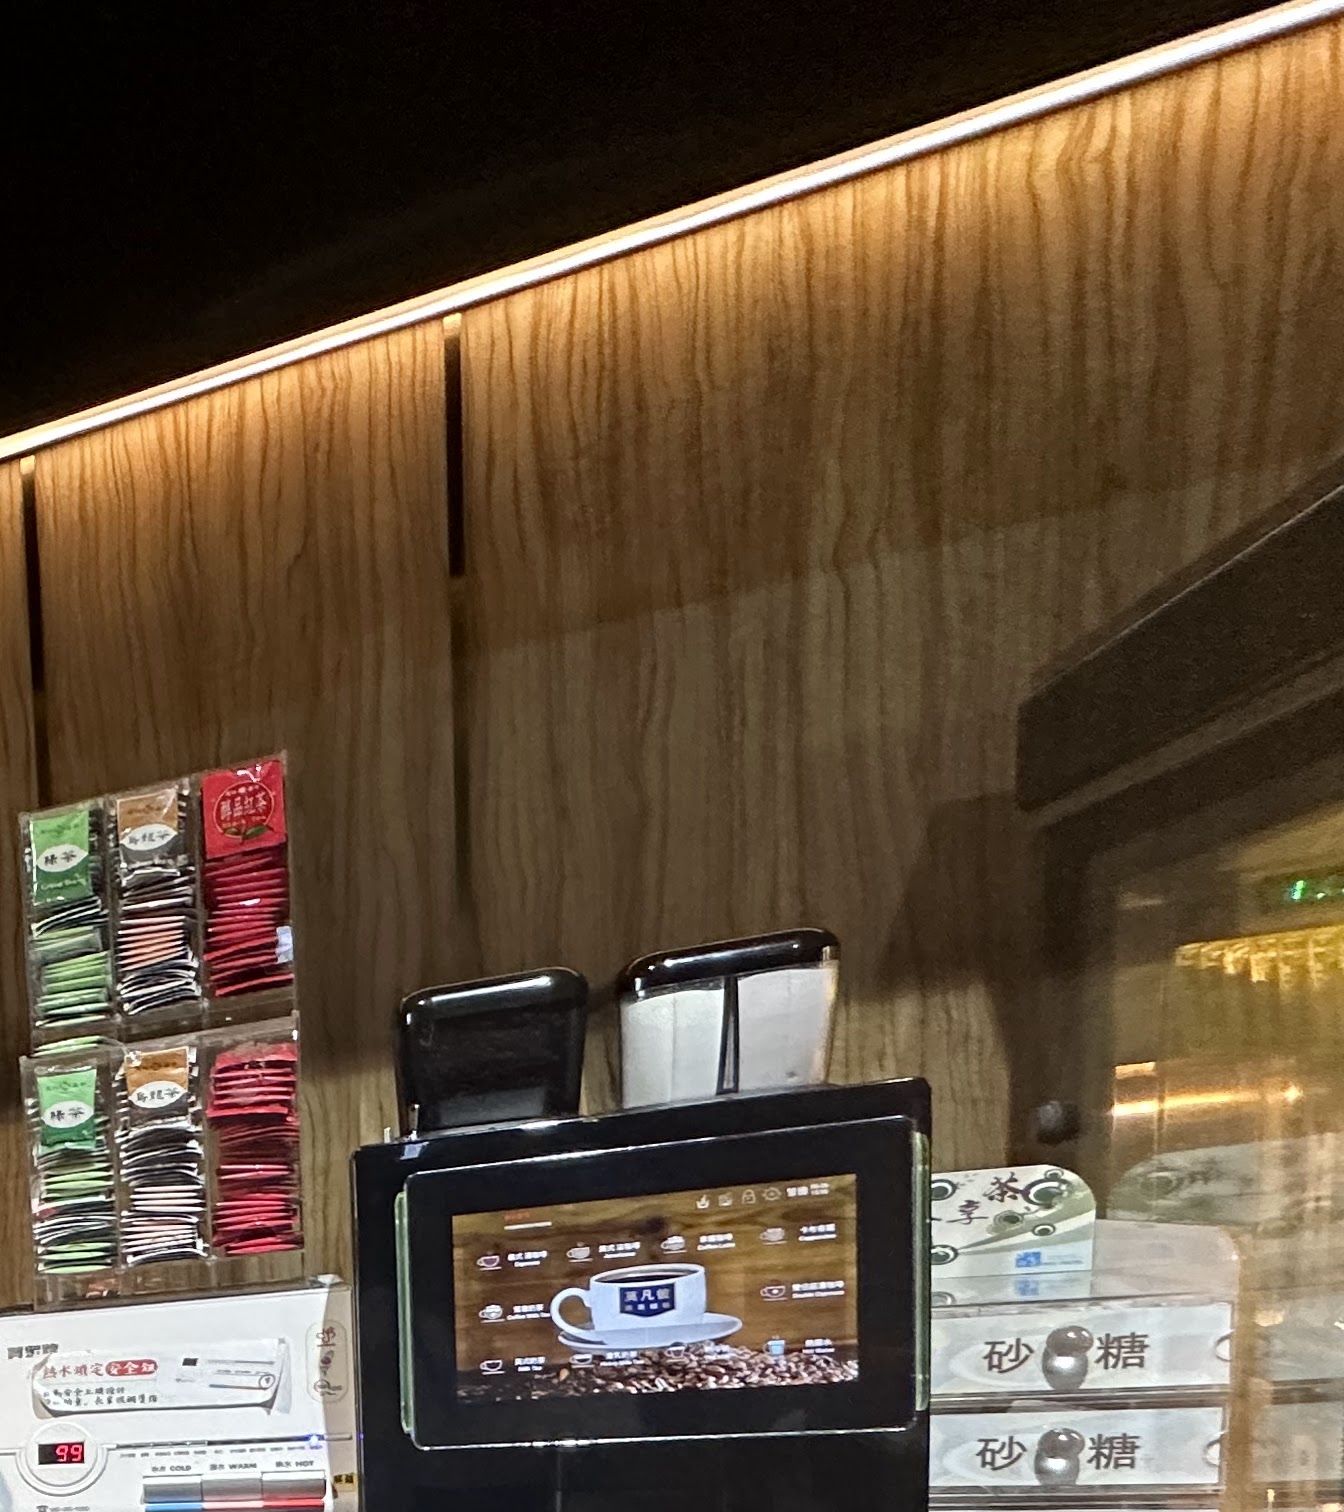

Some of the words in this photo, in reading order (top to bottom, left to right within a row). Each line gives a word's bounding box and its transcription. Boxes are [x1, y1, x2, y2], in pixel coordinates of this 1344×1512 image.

[983, 1331, 1150, 1374] 砂糖
[55, 1444, 83, 1462] 99
[976, 1432, 1141, 1471] 砂糖
